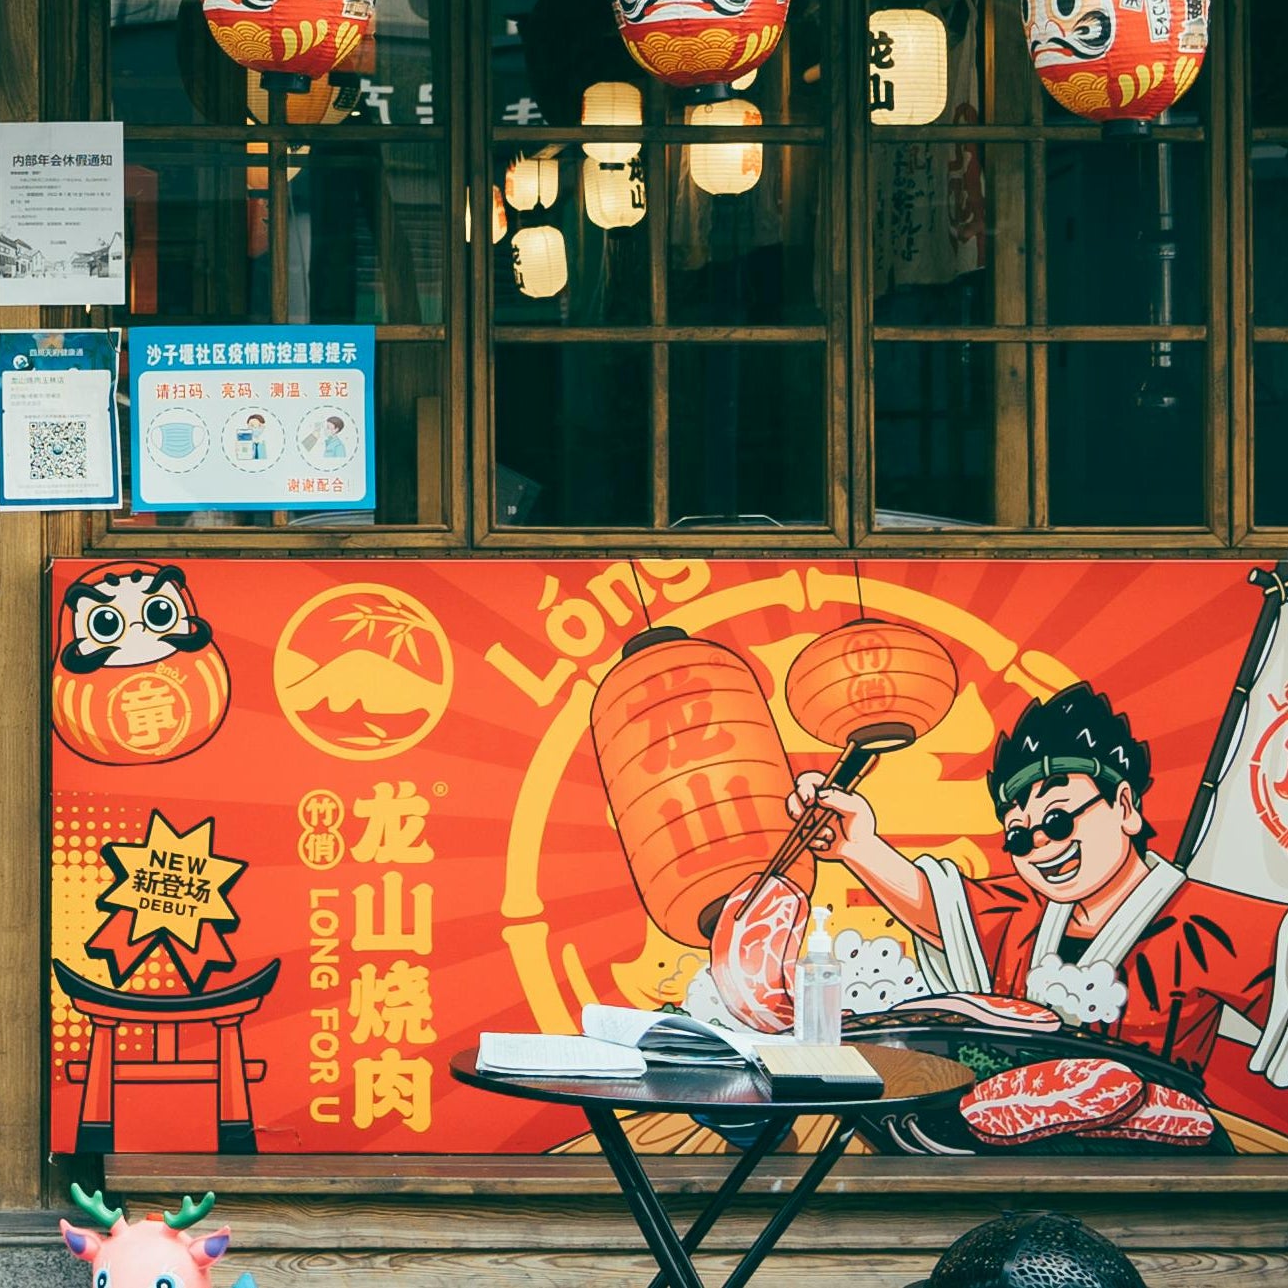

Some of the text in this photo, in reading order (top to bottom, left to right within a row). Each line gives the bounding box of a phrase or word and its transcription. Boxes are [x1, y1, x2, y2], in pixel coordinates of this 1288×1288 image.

[12, 153, 113, 168] 内部年会休假通知
[146, 342, 358, 366] 沙子堰社区疫情防控温馨提示
[625, 665, 770, 878] 龙山
[149, 849, 208, 876] NEW
[131, 868, 211, 904] 新登场
[139, 897, 199, 918] DEBUT
[349, 780, 438, 1134] 龙山烧肉
[309, 888, 340, 1124] LONG FOR U
